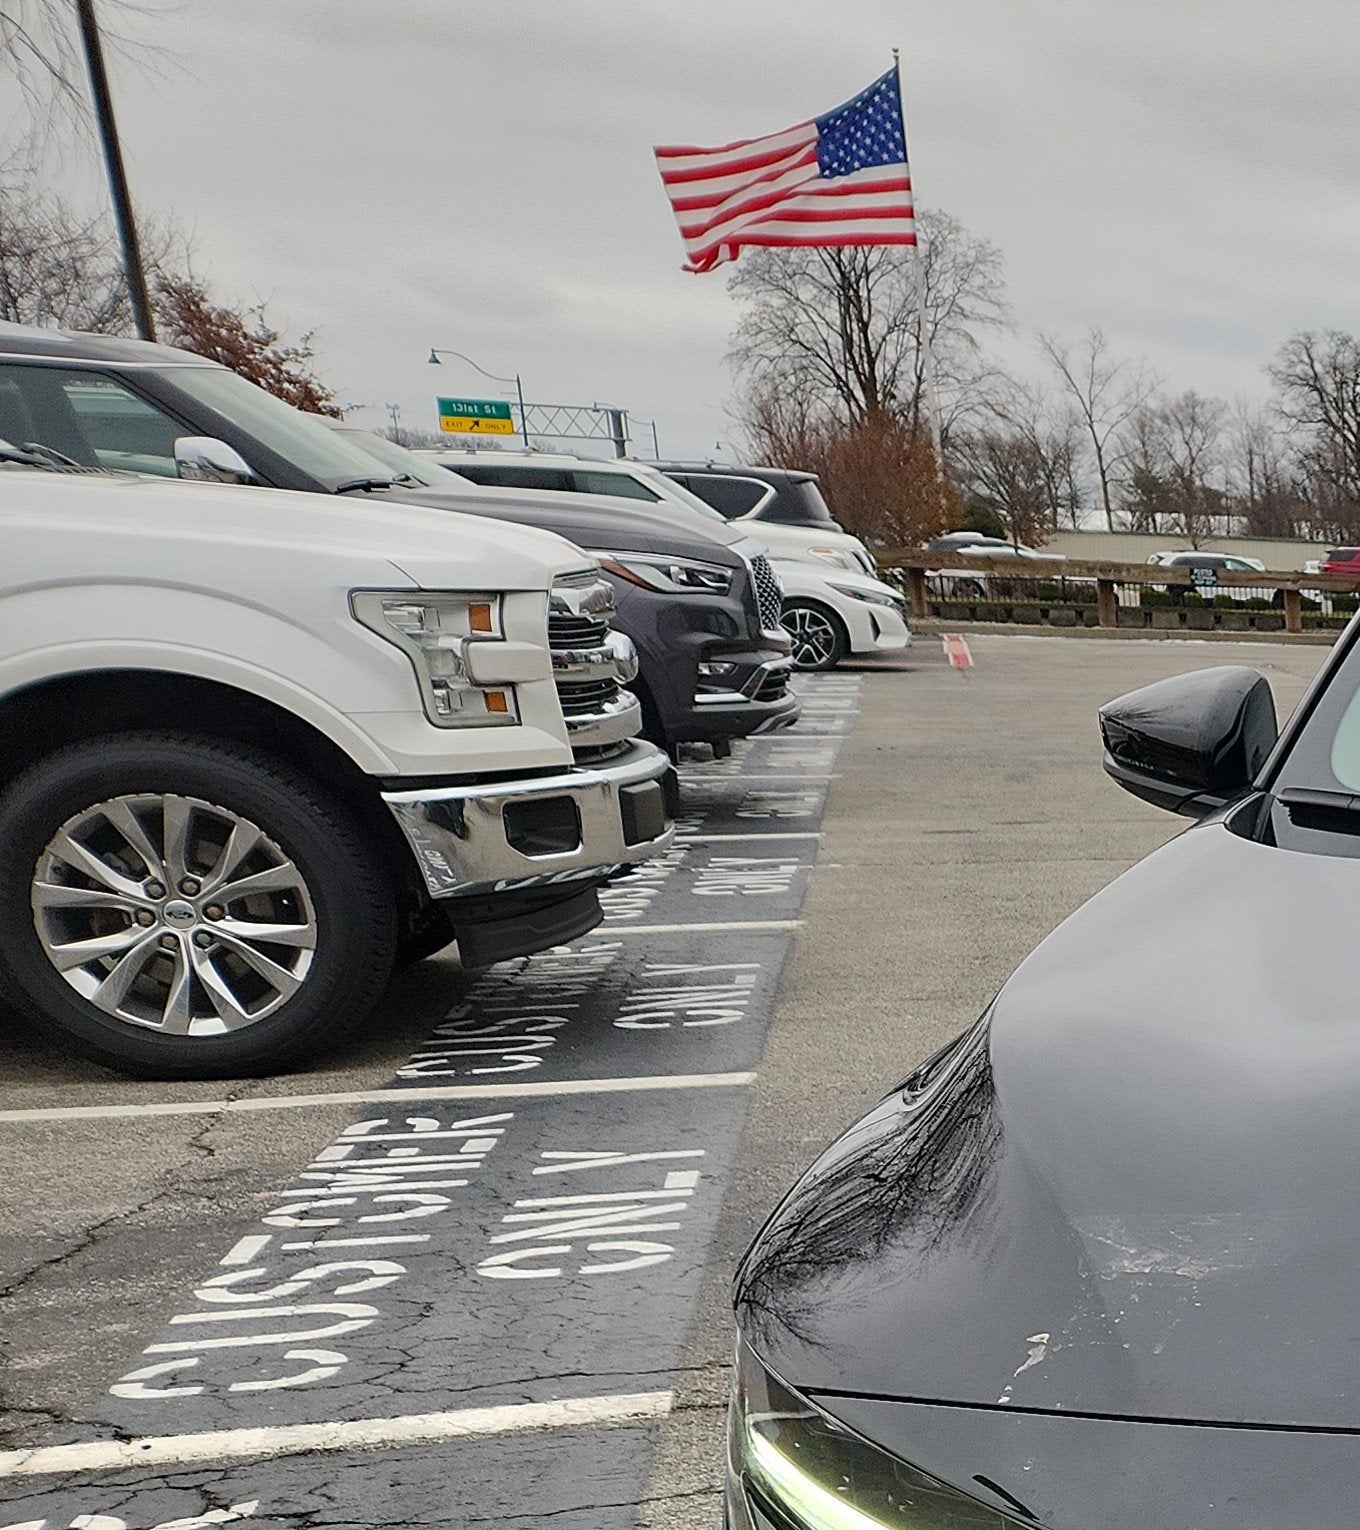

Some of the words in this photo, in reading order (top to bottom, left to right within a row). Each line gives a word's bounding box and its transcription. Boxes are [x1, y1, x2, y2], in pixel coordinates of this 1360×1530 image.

[445, 420, 463, 428] EXIT
[452, 403, 479, 414] 131st
[484, 404, 497, 414] St
[613, 963, 761, 1030] ONLY
[476, 1149, 706, 1280] ONLY
[109, 1112, 514, 1400] CUSTOMER
